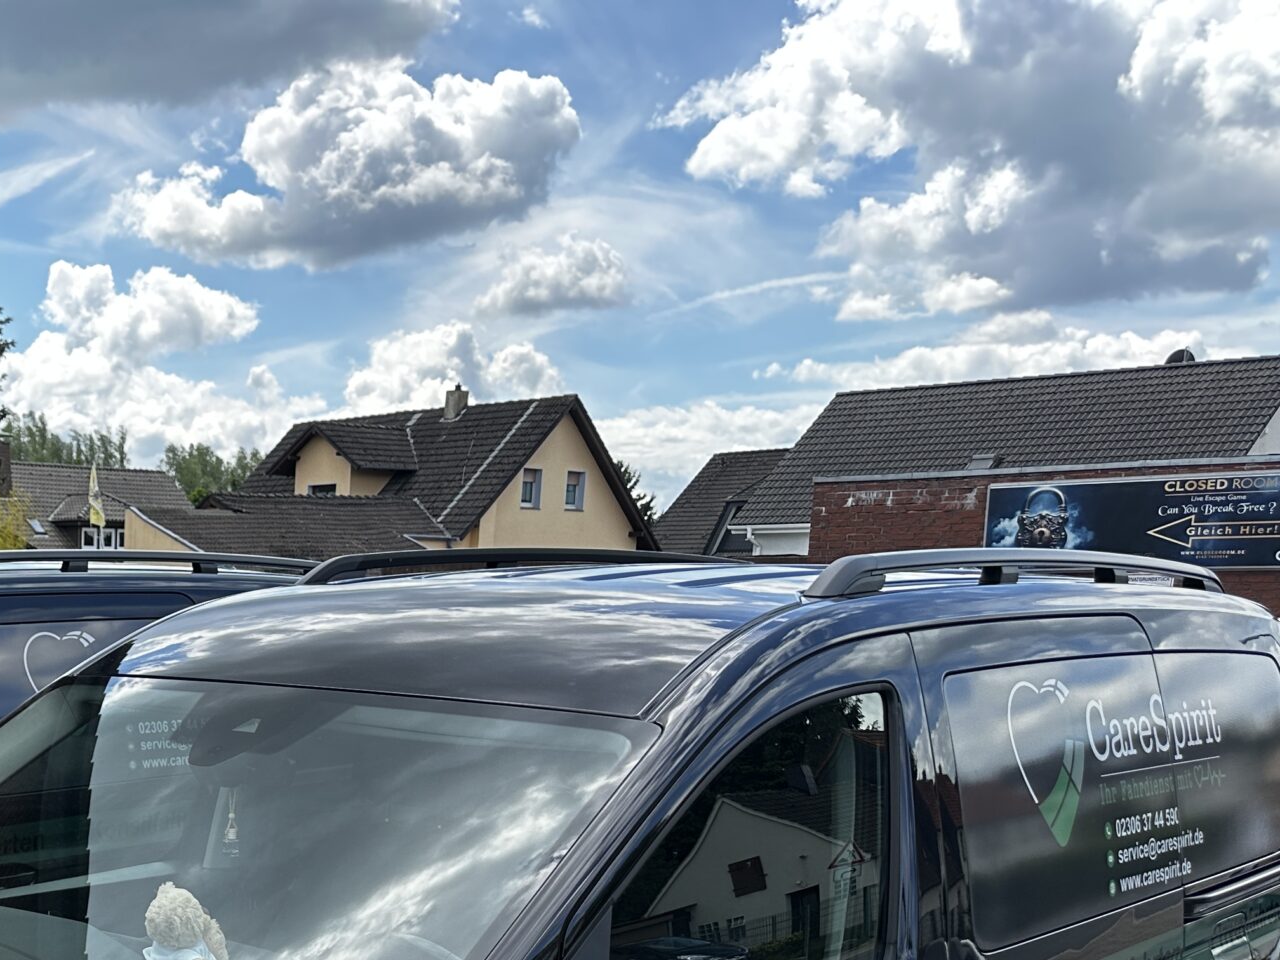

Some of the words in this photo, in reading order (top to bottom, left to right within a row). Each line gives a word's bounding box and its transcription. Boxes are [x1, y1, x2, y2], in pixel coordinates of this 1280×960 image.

[1164, 478, 1229, 493] CLOSED
[1191, 495, 1204, 503] Live
[1204, 494, 1226, 503] Escape
[1227, 493, 1247, 501] Game
[1158, 504, 1179, 517] Can
[1181, 503, 1199, 515] You
[1200, 503, 1235, 516] Break
[1236, 502, 1266, 515] Free
[1185, 526, 1233, 536] Gleich
[1239, 525, 1279, 535] Hier!
[138, 720, 170, 735] 02306
[1085, 692, 1222, 763] CareSpirit
[1099, 783, 1118, 806] Ihr
[1120, 774, 1175, 801] Fahrdienst
[1177, 769, 1193, 791] mit
[1115, 814, 1141, 838] 02306
[1142, 812, 1153, 832] 37
[1154, 809, 1165, 829] 44
[1118, 827, 1204, 864] service@carespirit.de
[1119, 858, 1192, 893] www.carespirit.de
